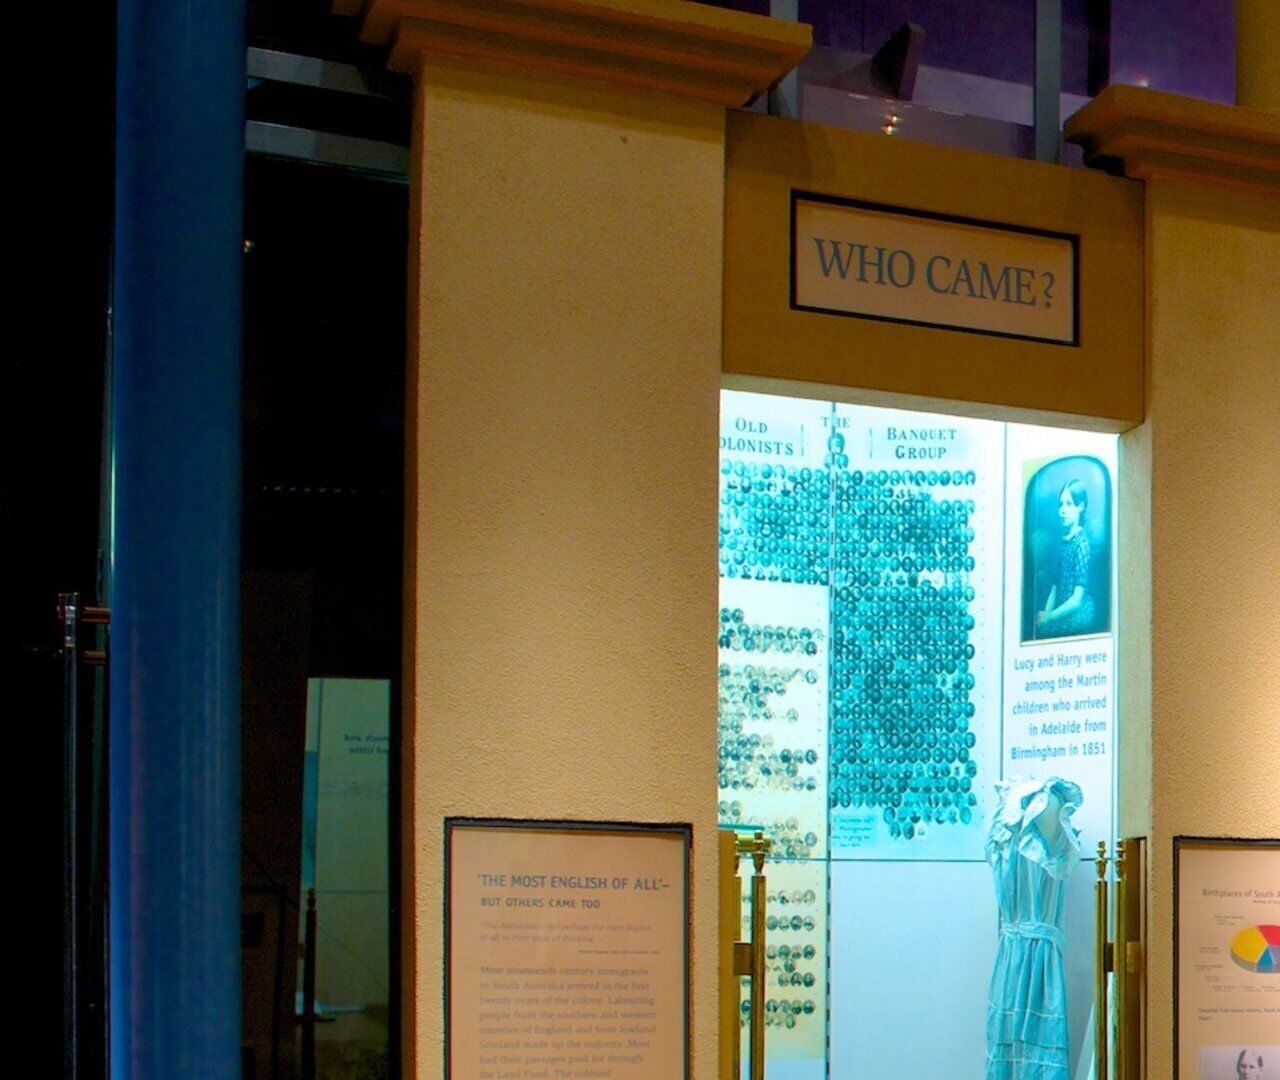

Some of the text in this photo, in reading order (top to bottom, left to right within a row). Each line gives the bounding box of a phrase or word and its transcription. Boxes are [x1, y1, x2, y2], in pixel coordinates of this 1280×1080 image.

[813, 237, 1055, 309] WHO CAME?
[720, 436, 794, 456] OLONISTS
[1014, 652, 1107, 672] Lucy and Harry were
[1025, 672, 1107, 693] among the Martin
[1012, 696, 1107, 715] children who arrived
[1029, 719, 1106, 735] in Adelaide from
[1011, 742, 1106, 761] Birmingham in 1851
[510, 875, 546, 889] MOST
[551, 876, 607, 890] ENGLISH
[612, 878, 628, 890] OF
[481, 898, 600, 909] BUT OTHERS CAME TOO
[1202, 888, 1243, 900] Birthplaces
[1246, 889, 1252, 898] of
[1254, 890, 1275, 899] South
